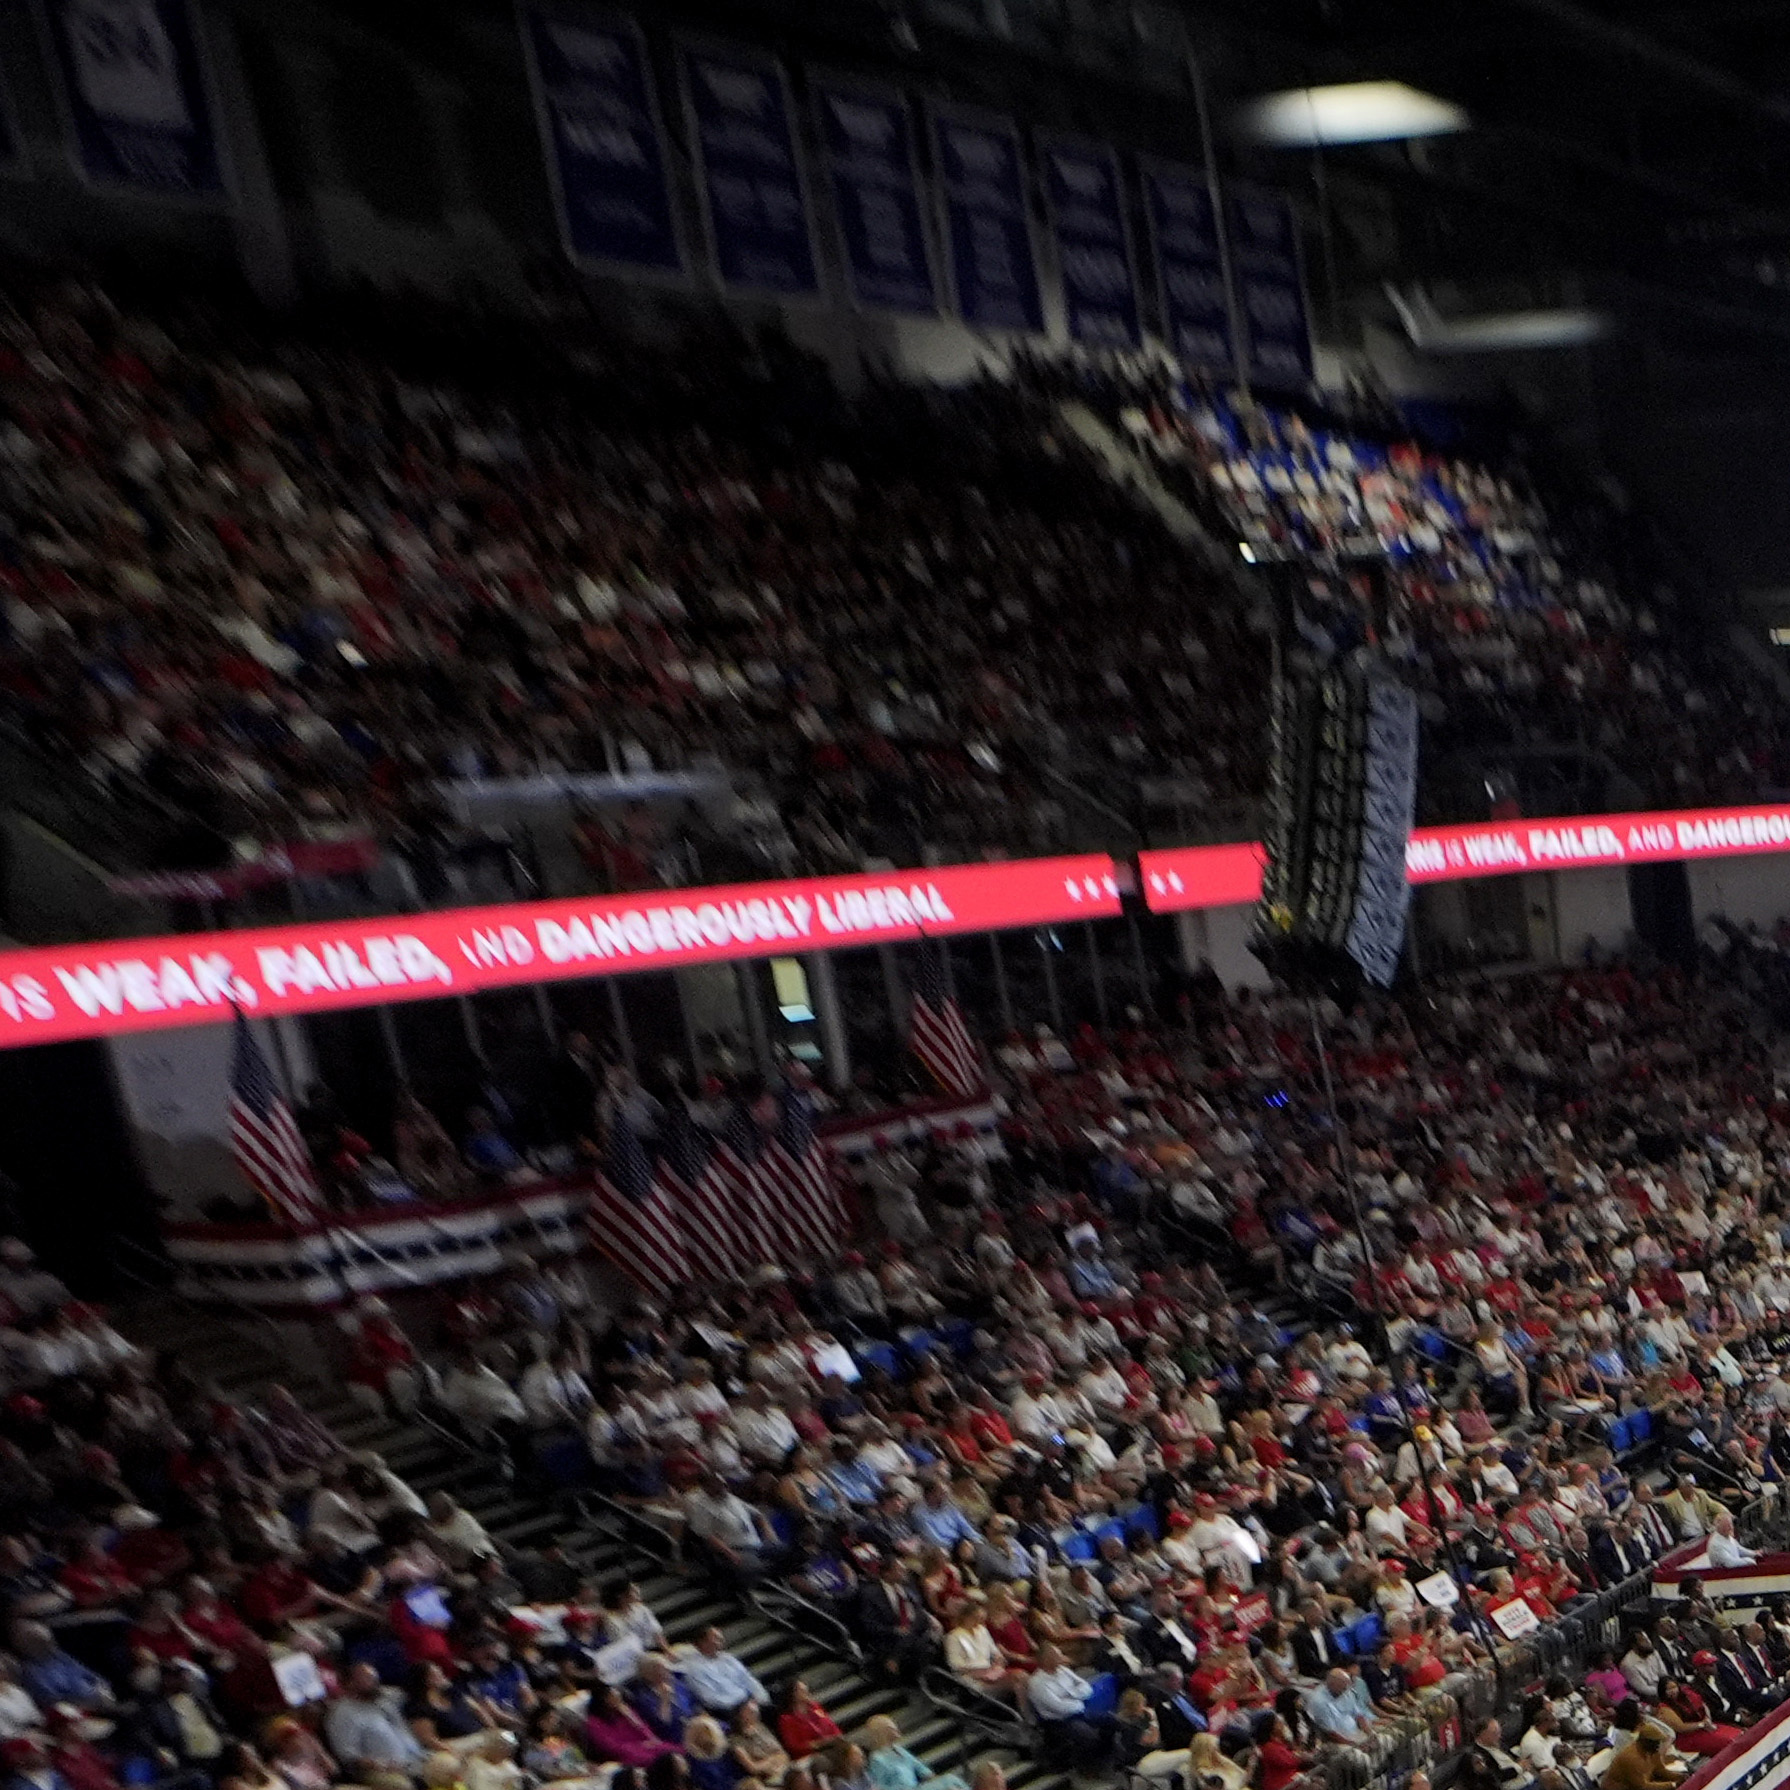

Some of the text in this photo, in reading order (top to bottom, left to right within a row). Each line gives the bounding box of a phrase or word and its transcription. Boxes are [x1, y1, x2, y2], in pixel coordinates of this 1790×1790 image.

[1463, 830, 1527, 867] WEAK,
[1527, 825, 1625, 862] FAILED,
[1627, 825, 1675, 852] AND
[51, 953, 259, 1018] WEAK,
[254, 932, 453, 998] FAILED,
[456, 925, 535, 970] AND
[534, 894, 813, 965] DANGEROUSLY
[815, 882, 955, 935] LIBERAL
